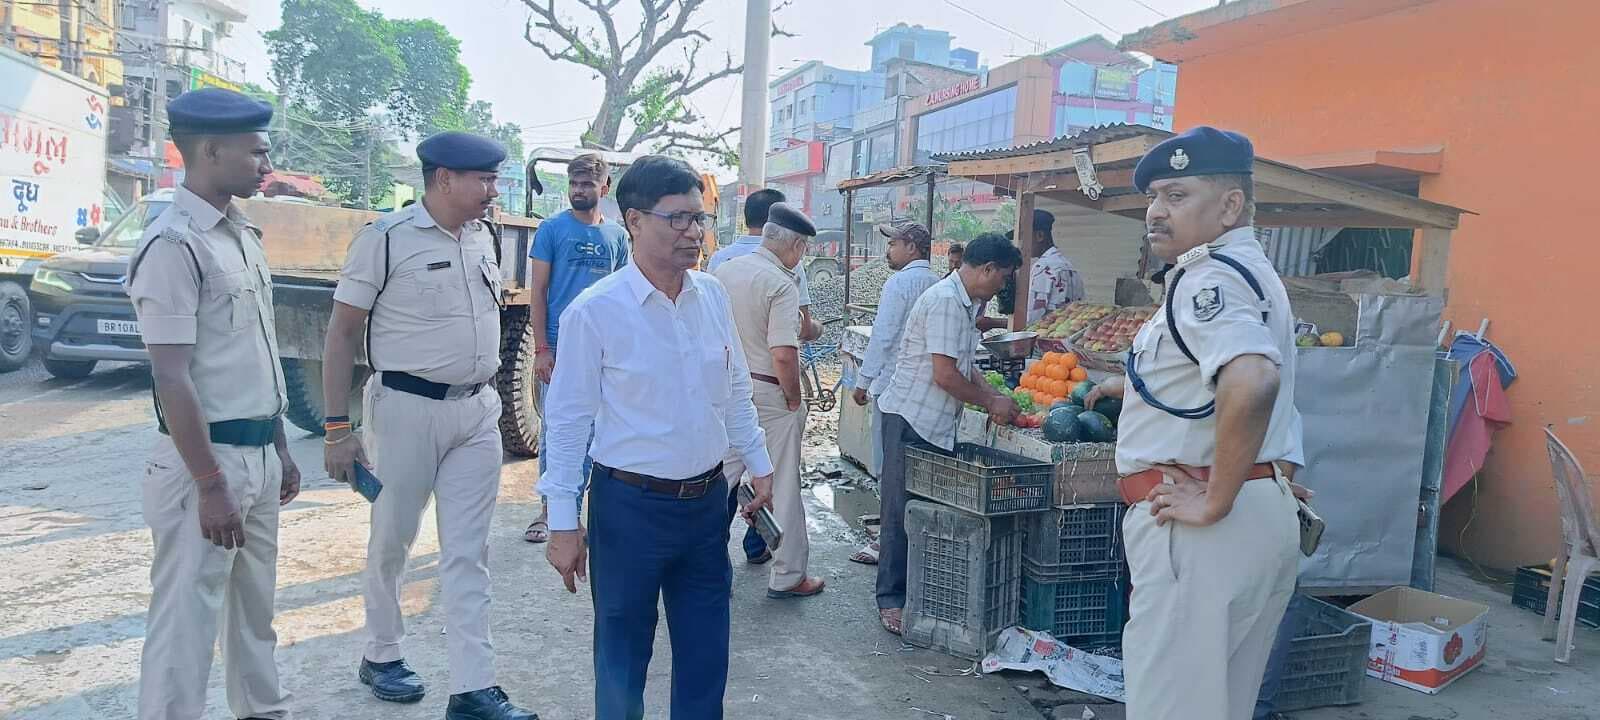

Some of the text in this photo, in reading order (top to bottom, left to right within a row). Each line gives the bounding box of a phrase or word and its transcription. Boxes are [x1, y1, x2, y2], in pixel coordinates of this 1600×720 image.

[958, 78, 981, 96] HOME
[12, 178, 40, 213] दूध
[11, 215, 18, 231] &
[21, 215, 58, 236] Brothers
